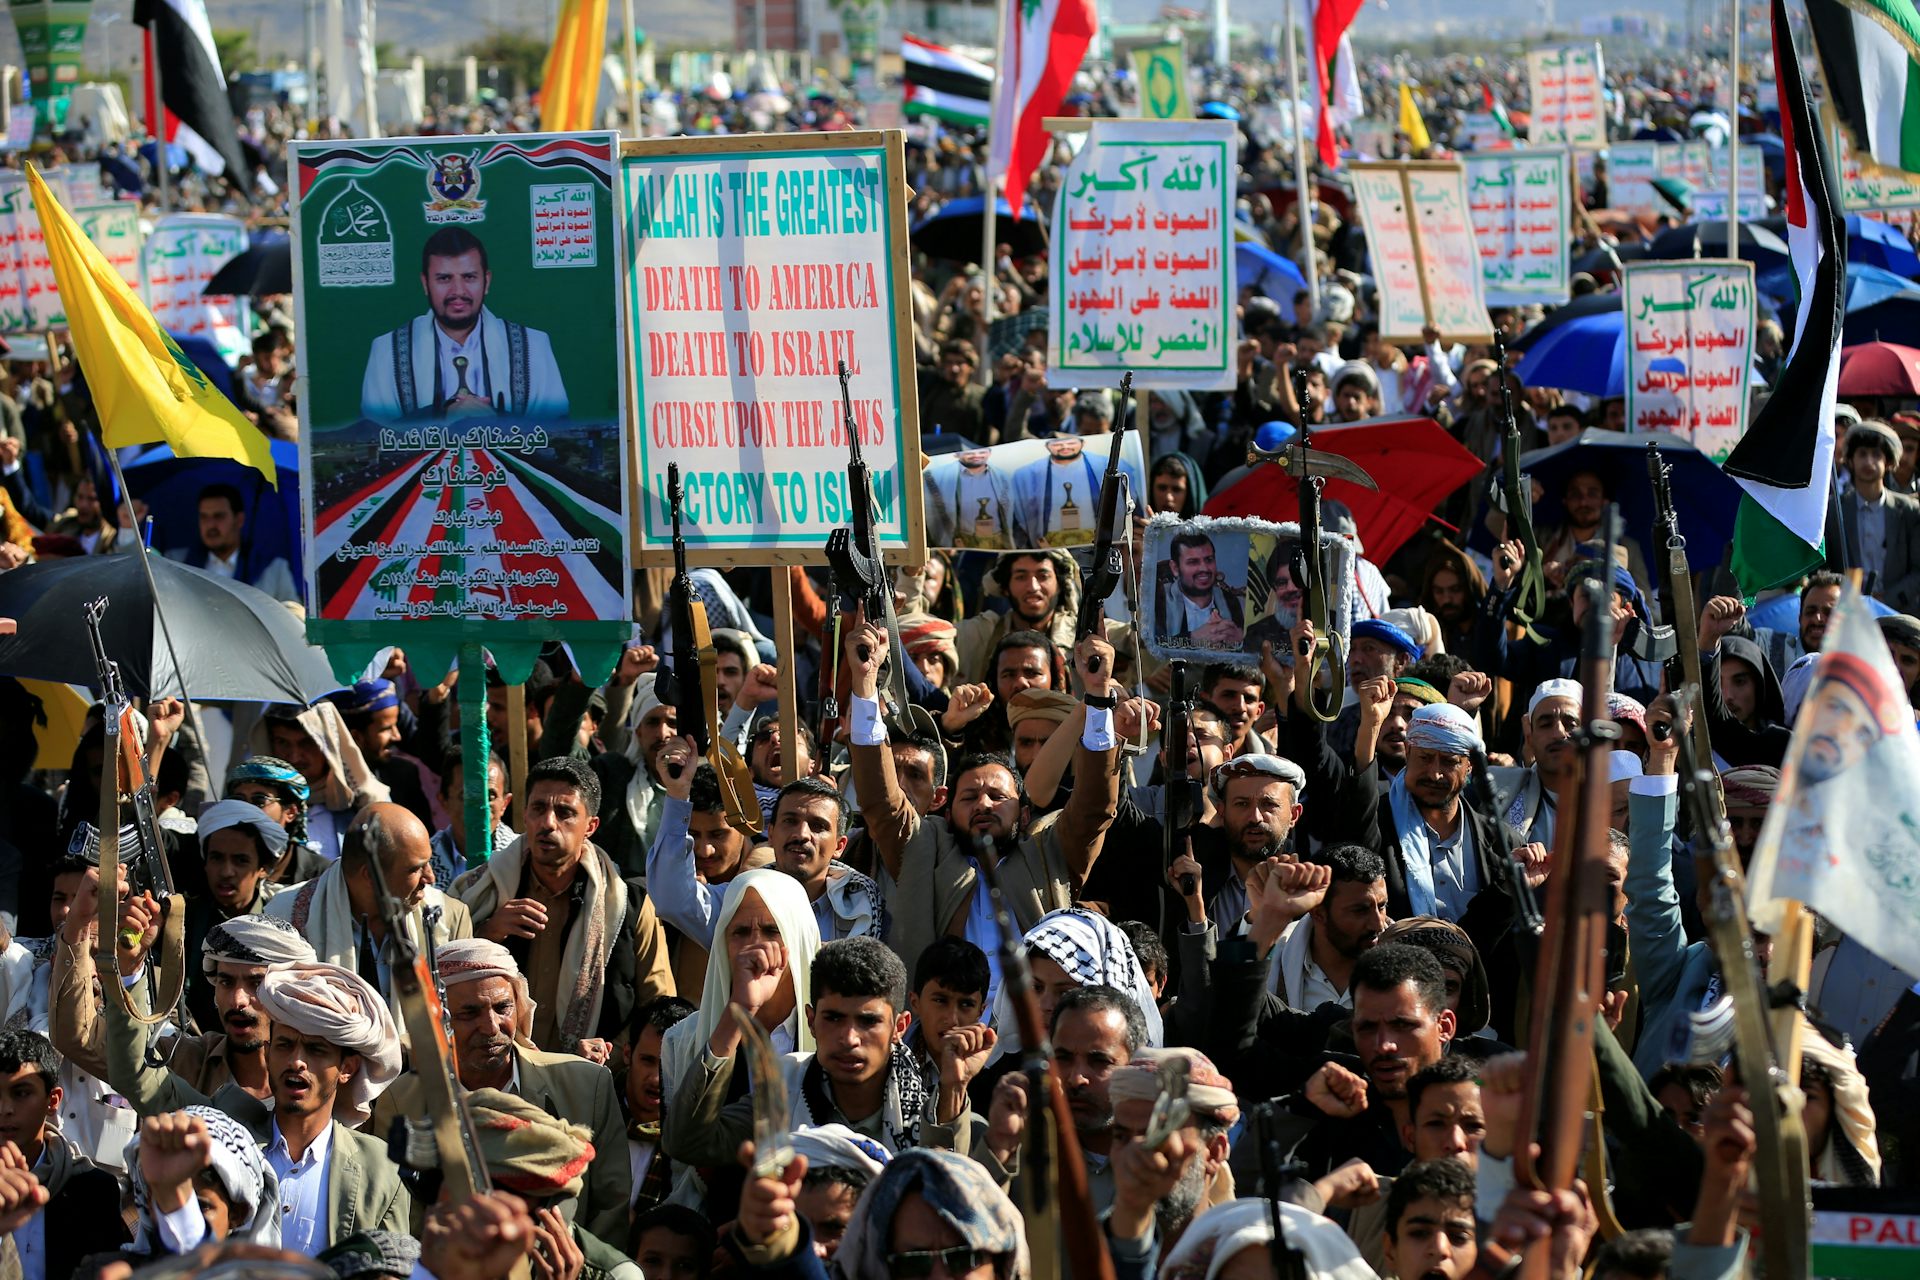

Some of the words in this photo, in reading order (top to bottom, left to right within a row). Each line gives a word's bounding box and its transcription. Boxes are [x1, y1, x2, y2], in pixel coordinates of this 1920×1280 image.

[1069, 150, 1158, 203] أكبر
[1162, 154, 1217, 191] الله
[1525, 164, 1556, 186] الله
[535, 187, 568, 205] أكبر
[571, 188, 591, 201] الله
[638, 174, 700, 239] ALLAH
[705, 172, 724, 239] IS
[729, 171, 770, 237] THE
[775, 167, 879, 237] GREATEST
[568, 207, 591, 218] الموت
[1069, 202, 1146, 236] لأمريكا
[1153, 207, 1217, 236] الموت
[568, 220, 592, 231] الموت
[536, 236, 557, 247] اليهود
[560, 236, 570, 246] على
[574, 235, 592, 243] اللعنة
[536, 249, 565, 263] للإسلام
[568, 247, 593, 262] النصر
[1068, 245, 1146, 276] لإسرائيل
[1154, 246, 1217, 276] الموت
[644, 266, 723, 311] DEATH
[728, 265, 761, 311] TO
[768, 262, 879, 310] AMERICA
[1170, 284, 1218, 309] اللعنة
[1635, 272, 1716, 325] أكبر
[1711, 275, 1746, 311] الله
[1068, 285, 1123, 316] اليهود
[1130, 285, 1160, 315] على
[1068, 322, 1144, 362] للإسلام
[1151, 319, 1217, 360] النصر
[1695, 327, 1744, 352] الموت
[648, 331, 728, 377] DEATH
[734, 331, 765, 377] TO
[771, 330, 861, 377] ISRAEL
[1695, 366, 1740, 392] الموت
[652, 401, 719, 449] CURSE
[722, 401, 777, 448] UPON
[782, 401, 825, 448] THE
[1638, 407, 1686, 432] اليهود
[380, 426, 443, 451] قائدنا
[443, 427, 460, 456] يا
[461, 425, 548, 455] فوضناك
[420, 463, 508, 493] فوضناك
[656, 471, 764, 525] VCTORY
[773, 471, 808, 524] TO
[815, 470, 894, 524] ISLM
[432, 509, 475, 528] ونبارك
[335, 541, 378, 562] الحوثي
[508, 539, 539, 557] السيد
[539, 538, 569, 557] الثورة
[570, 538, 600, 555] لقائد
[416, 570, 458, 588] الشريف
[458, 569, 492, 588] النبوي
[494, 570, 521, 586] المولد
[375, 601, 420, 620] والتسليم
[420, 601, 453, 617] الصلاة
[506, 600, 544, 618] صاحبه
[545, 598, 568, 618] على
[1848, 1216, 1920, 1246] PAL
